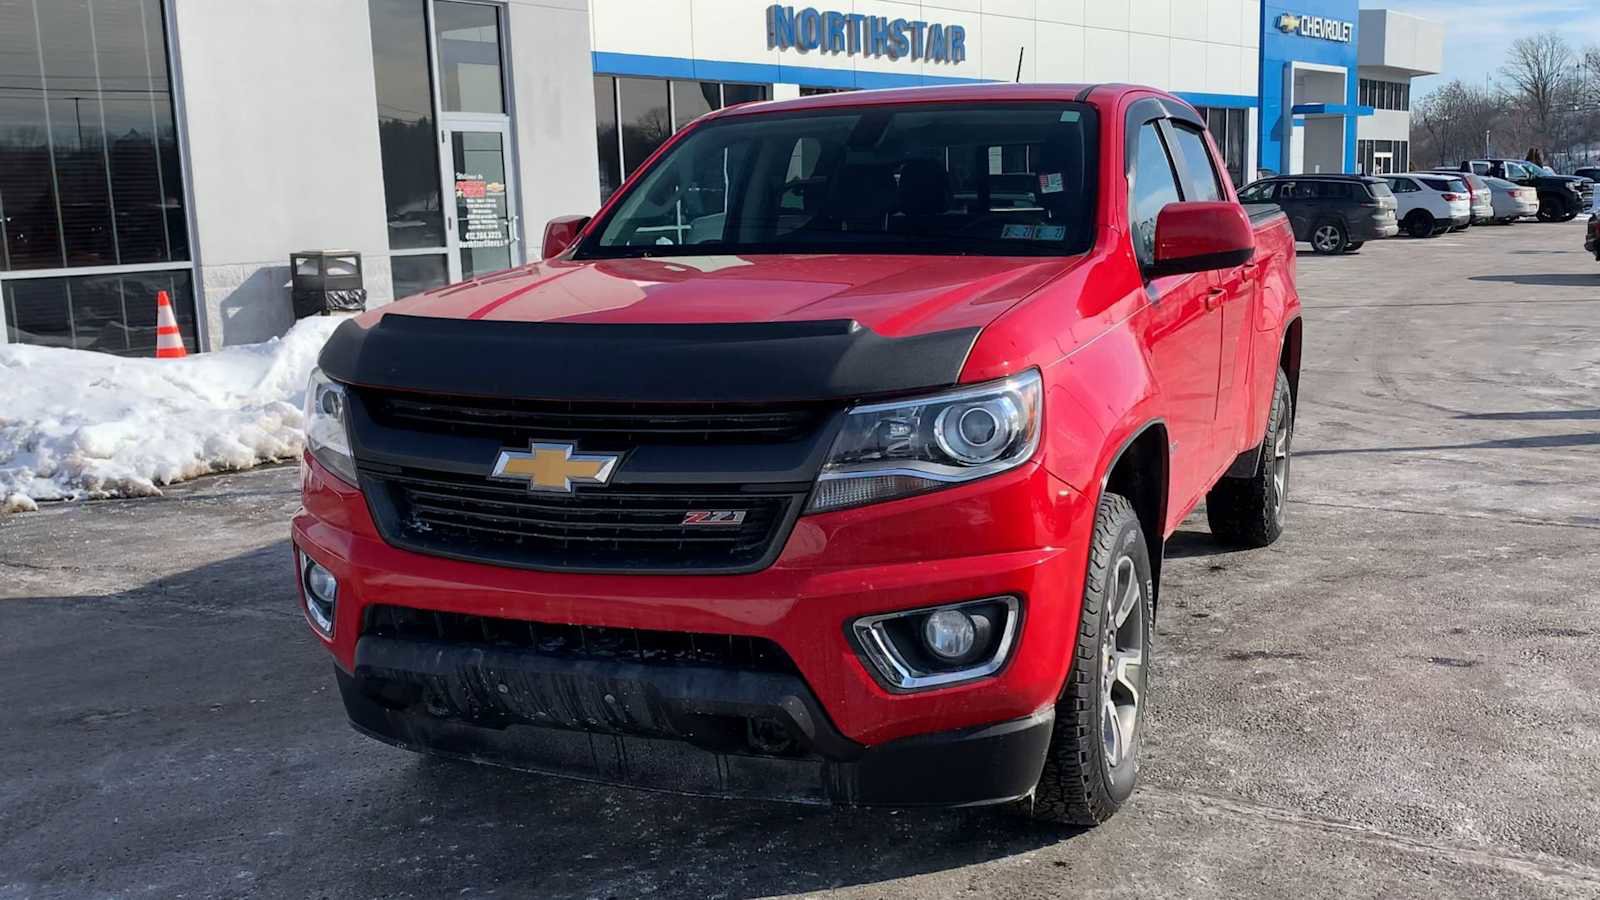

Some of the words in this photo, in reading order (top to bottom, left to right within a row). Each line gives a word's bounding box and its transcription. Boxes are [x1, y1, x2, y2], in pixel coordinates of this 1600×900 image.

[767, 4, 966, 65] NORTHSTAR
[1301, 15, 1354, 42] CHEVROLET
[681, 511, 746, 525] Z71
